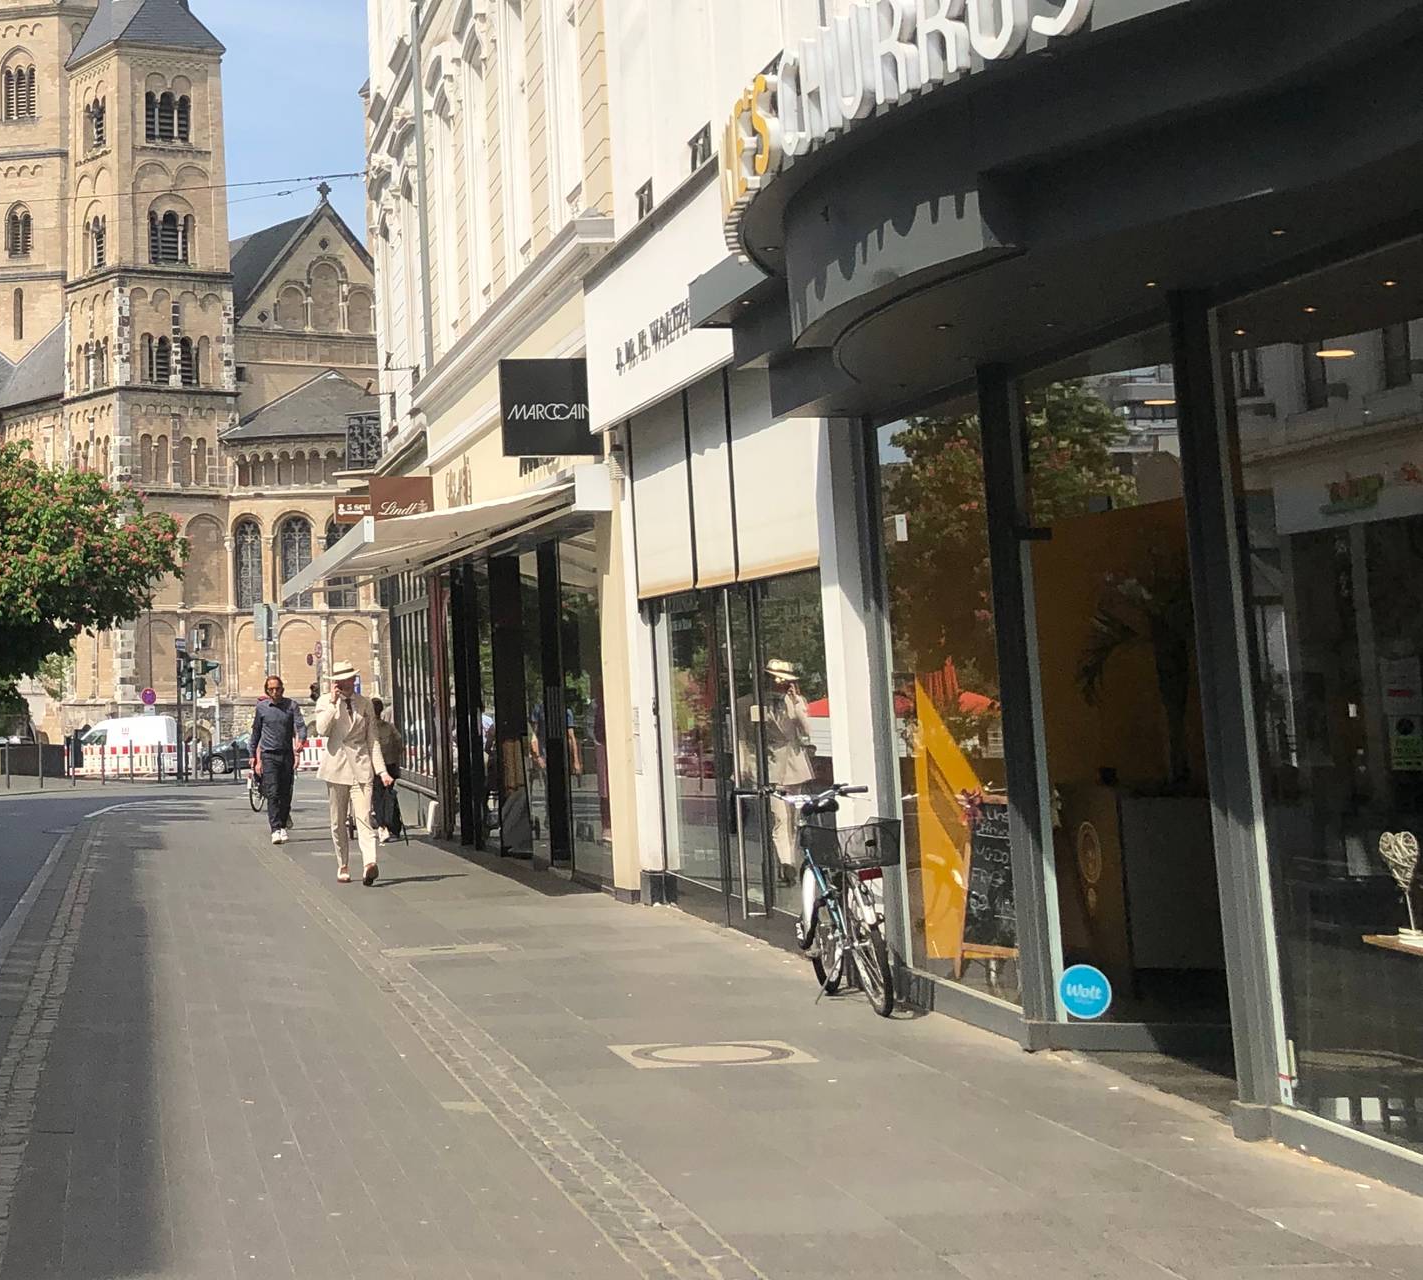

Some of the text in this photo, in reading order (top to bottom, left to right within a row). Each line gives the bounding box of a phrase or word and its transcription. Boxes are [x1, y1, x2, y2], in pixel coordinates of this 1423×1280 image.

[777, 0, 1090, 156] CHURR
[377, 501, 418, 516] Lindt
[1066, 983, 1103, 1000] Wolt
